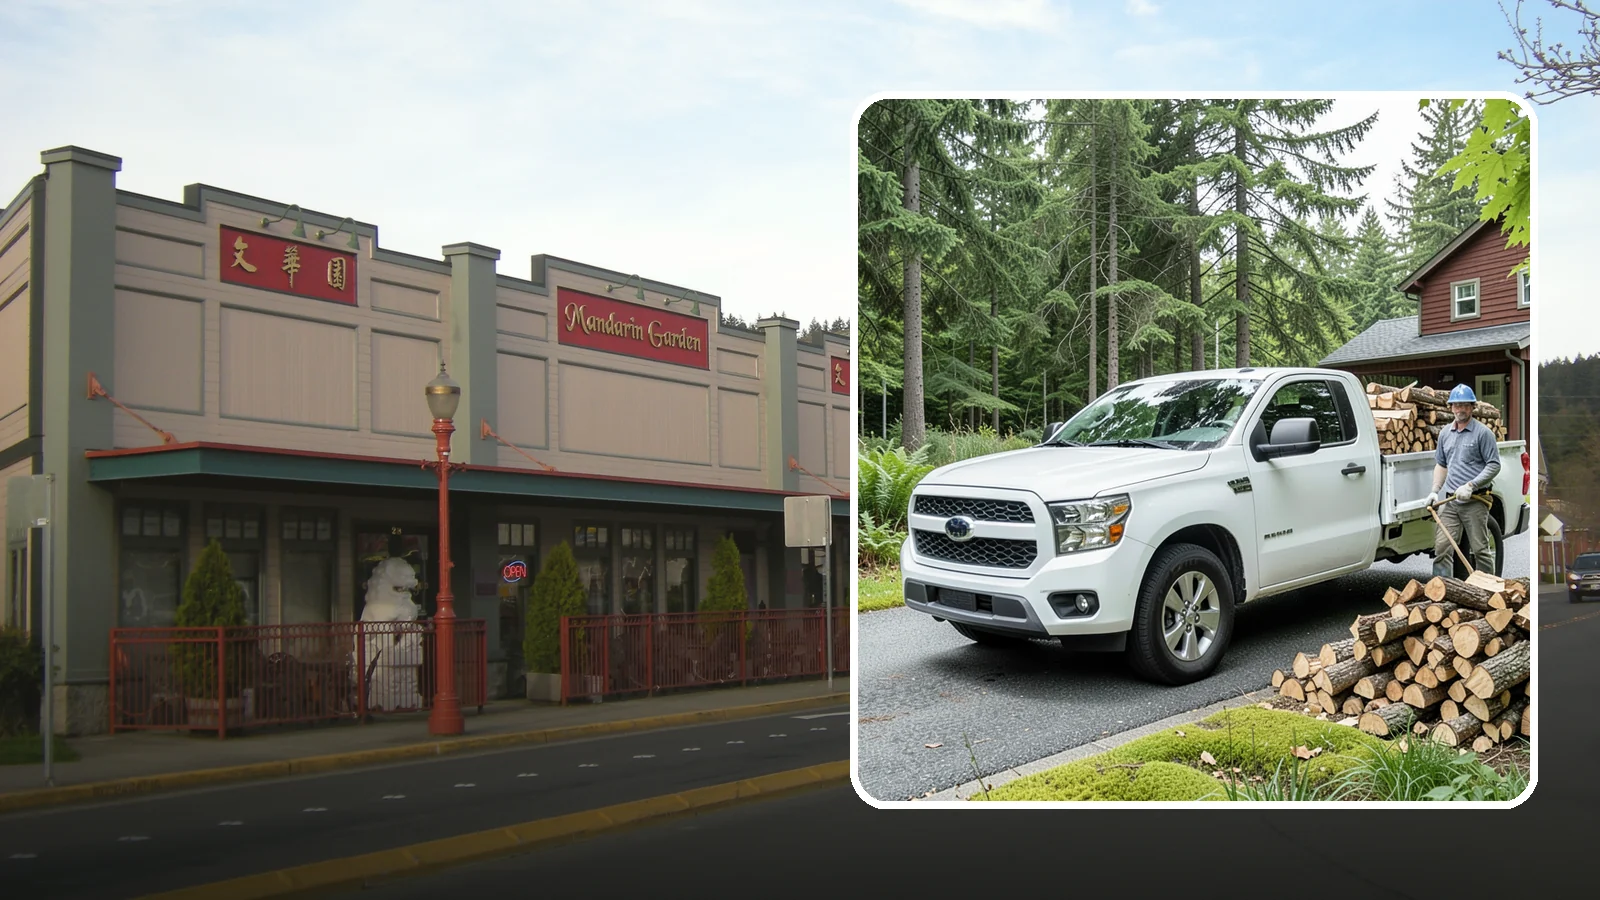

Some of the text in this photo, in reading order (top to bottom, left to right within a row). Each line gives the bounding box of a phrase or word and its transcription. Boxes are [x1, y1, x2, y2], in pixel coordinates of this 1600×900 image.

[231, 237, 345, 290] 文華園
[565, 302, 701, 352] Mandarin Garden
[835, 363, 846, 386] 文
[503, 565, 527, 578] OPEN
